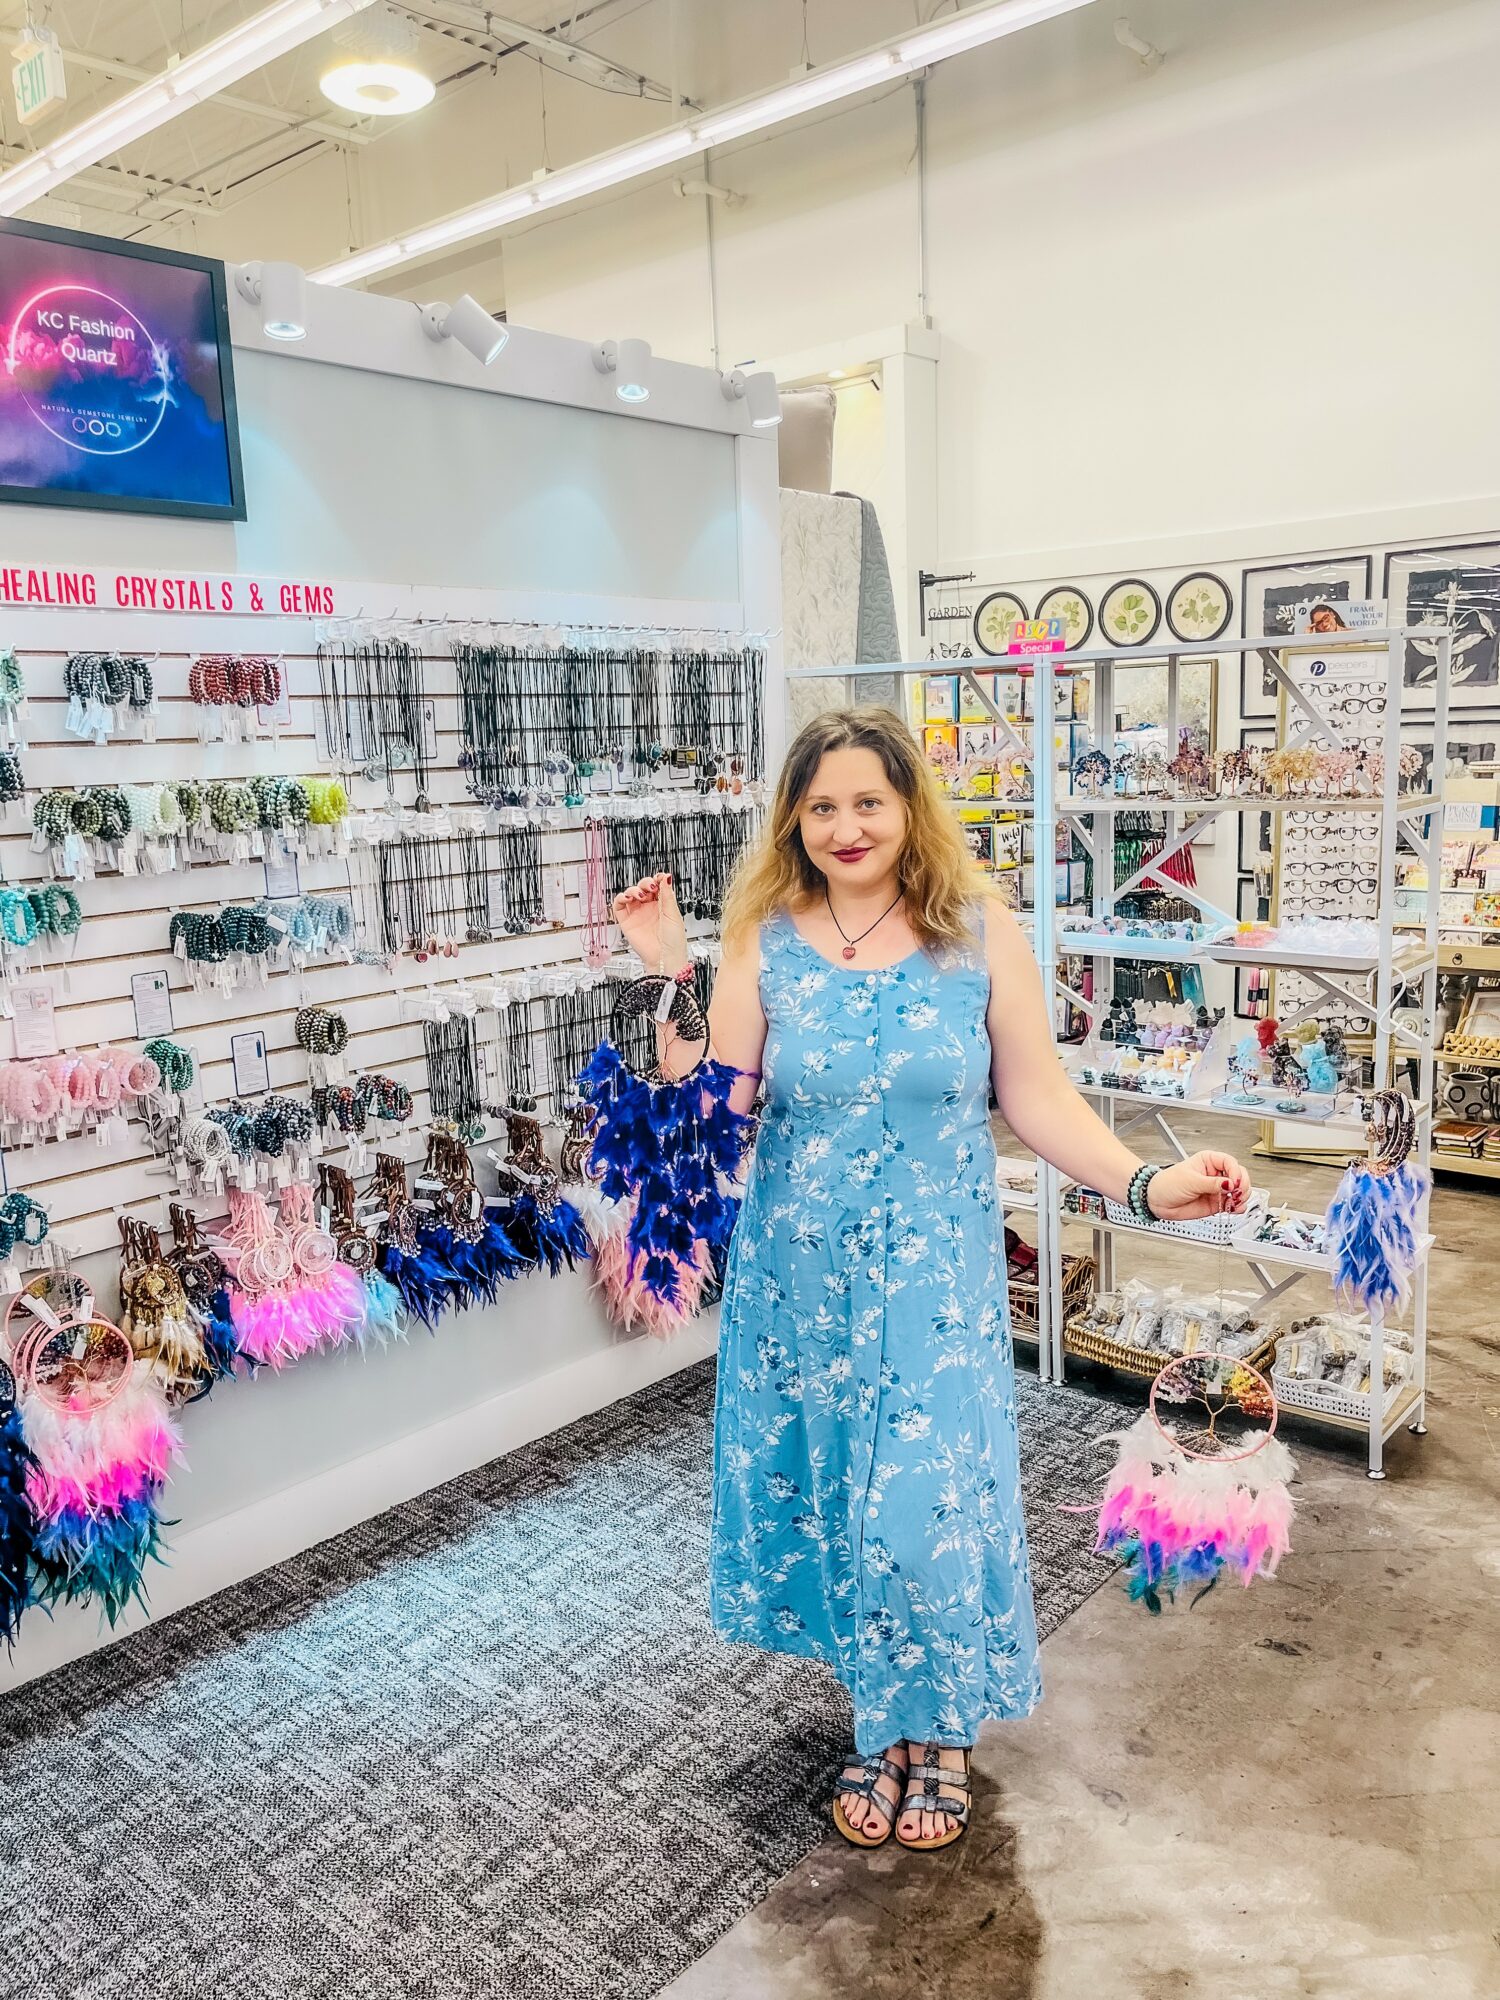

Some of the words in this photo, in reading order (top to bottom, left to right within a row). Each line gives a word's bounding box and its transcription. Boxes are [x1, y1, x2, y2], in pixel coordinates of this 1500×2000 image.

[19, 50, 47, 112] EXIT
[37, 310, 64, 330] KC
[69, 315, 135, 341] Fashion
[61, 342, 118, 366] Quartz
[41, 404, 75, 414] NATURAL
[77, 409, 116, 419] GEMSTONE
[118, 414, 148, 424] JEWELRY
[116, 576, 233, 611] CRYSTALS
[249, 582, 264, 612] &
[280, 584, 335, 615] GEMS
[928, 606, 973, 618] GARDEN
[1016, 620, 1059, 638] RSVP
[1020, 640, 1053, 654] Special
[1328, 661, 1368, 672] peepers
[1000, 827, 1020, 843] Wild
